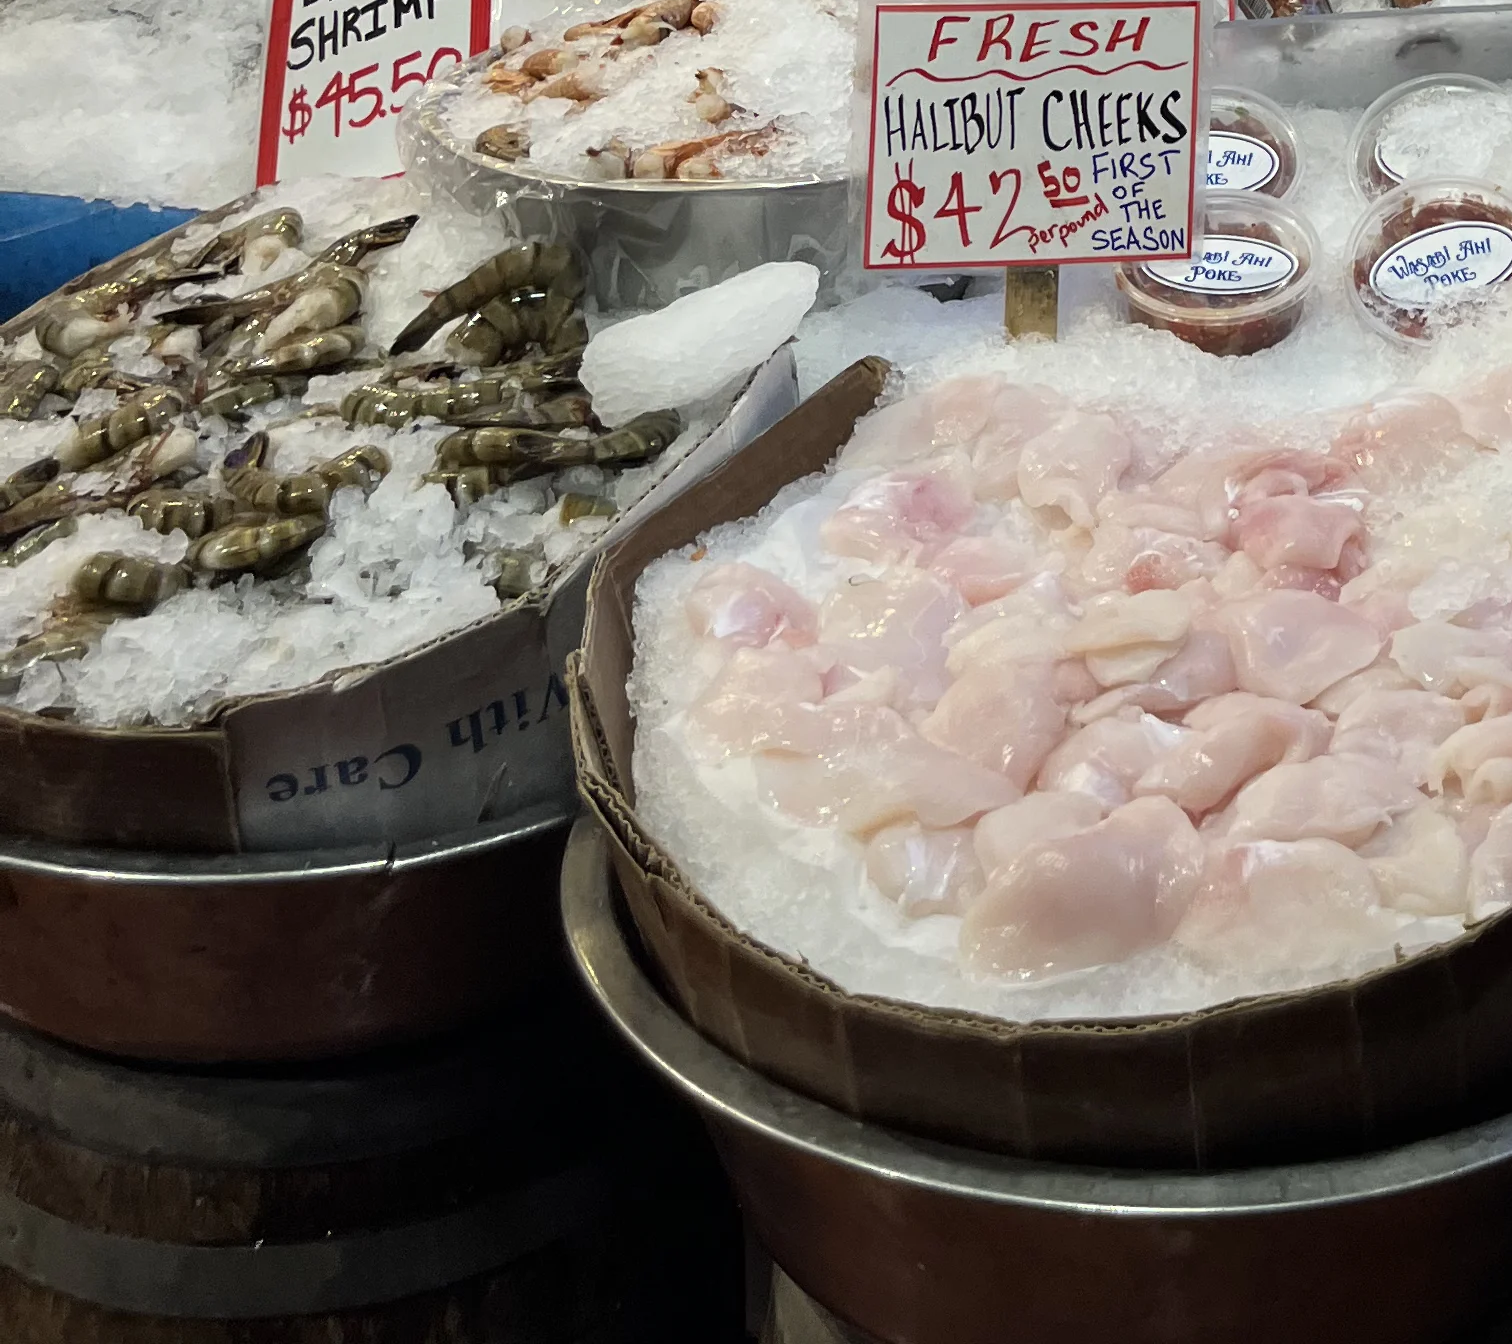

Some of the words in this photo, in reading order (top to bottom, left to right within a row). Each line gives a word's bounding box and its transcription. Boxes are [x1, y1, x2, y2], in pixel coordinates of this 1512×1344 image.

[928, 13, 1150, 62] FRESH
[884, 86, 1025, 157] HALIBUT
[1043, 89, 1187, 152] CHEEKS
[1092, 150, 1180, 183] FIRST
[1216, 150, 1253, 167] AHI
[1112, 182, 1145, 200] OF
[1120, 199, 1166, 223] THE
[1092, 228, 1184, 252] SEASON
[1232, 252, 1272, 268] AHI
[1184, 266, 1242, 282] POKE
[265, 743, 422, 802] Care
